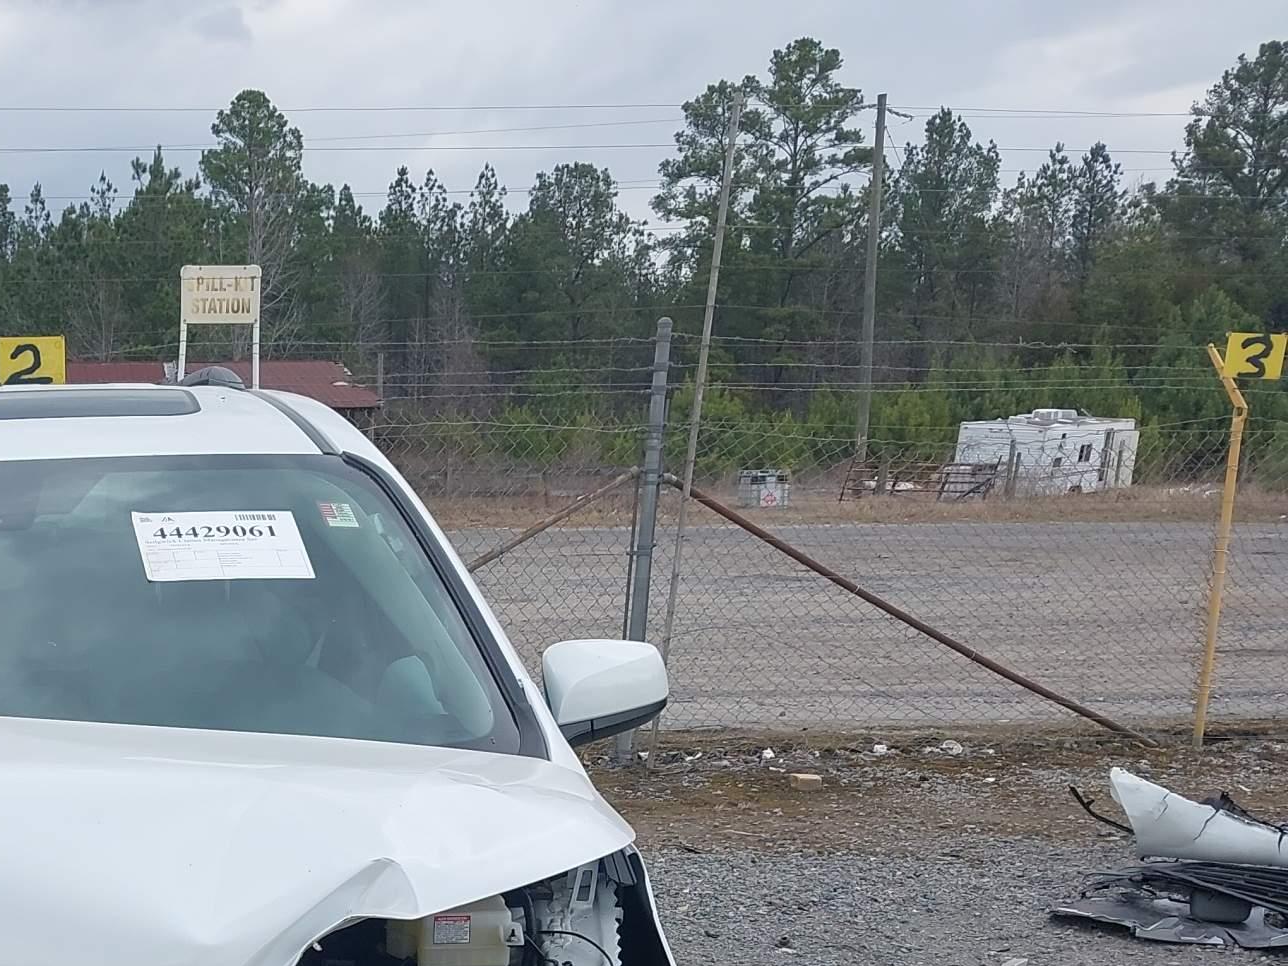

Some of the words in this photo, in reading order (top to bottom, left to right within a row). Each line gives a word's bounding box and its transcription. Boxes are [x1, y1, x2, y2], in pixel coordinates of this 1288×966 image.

[191, 298, 251, 314] STATION
[3, 343, 54, 385] 2
[1237, 335, 1274, 378] 3
[152, 525, 278, 540] 44429061
